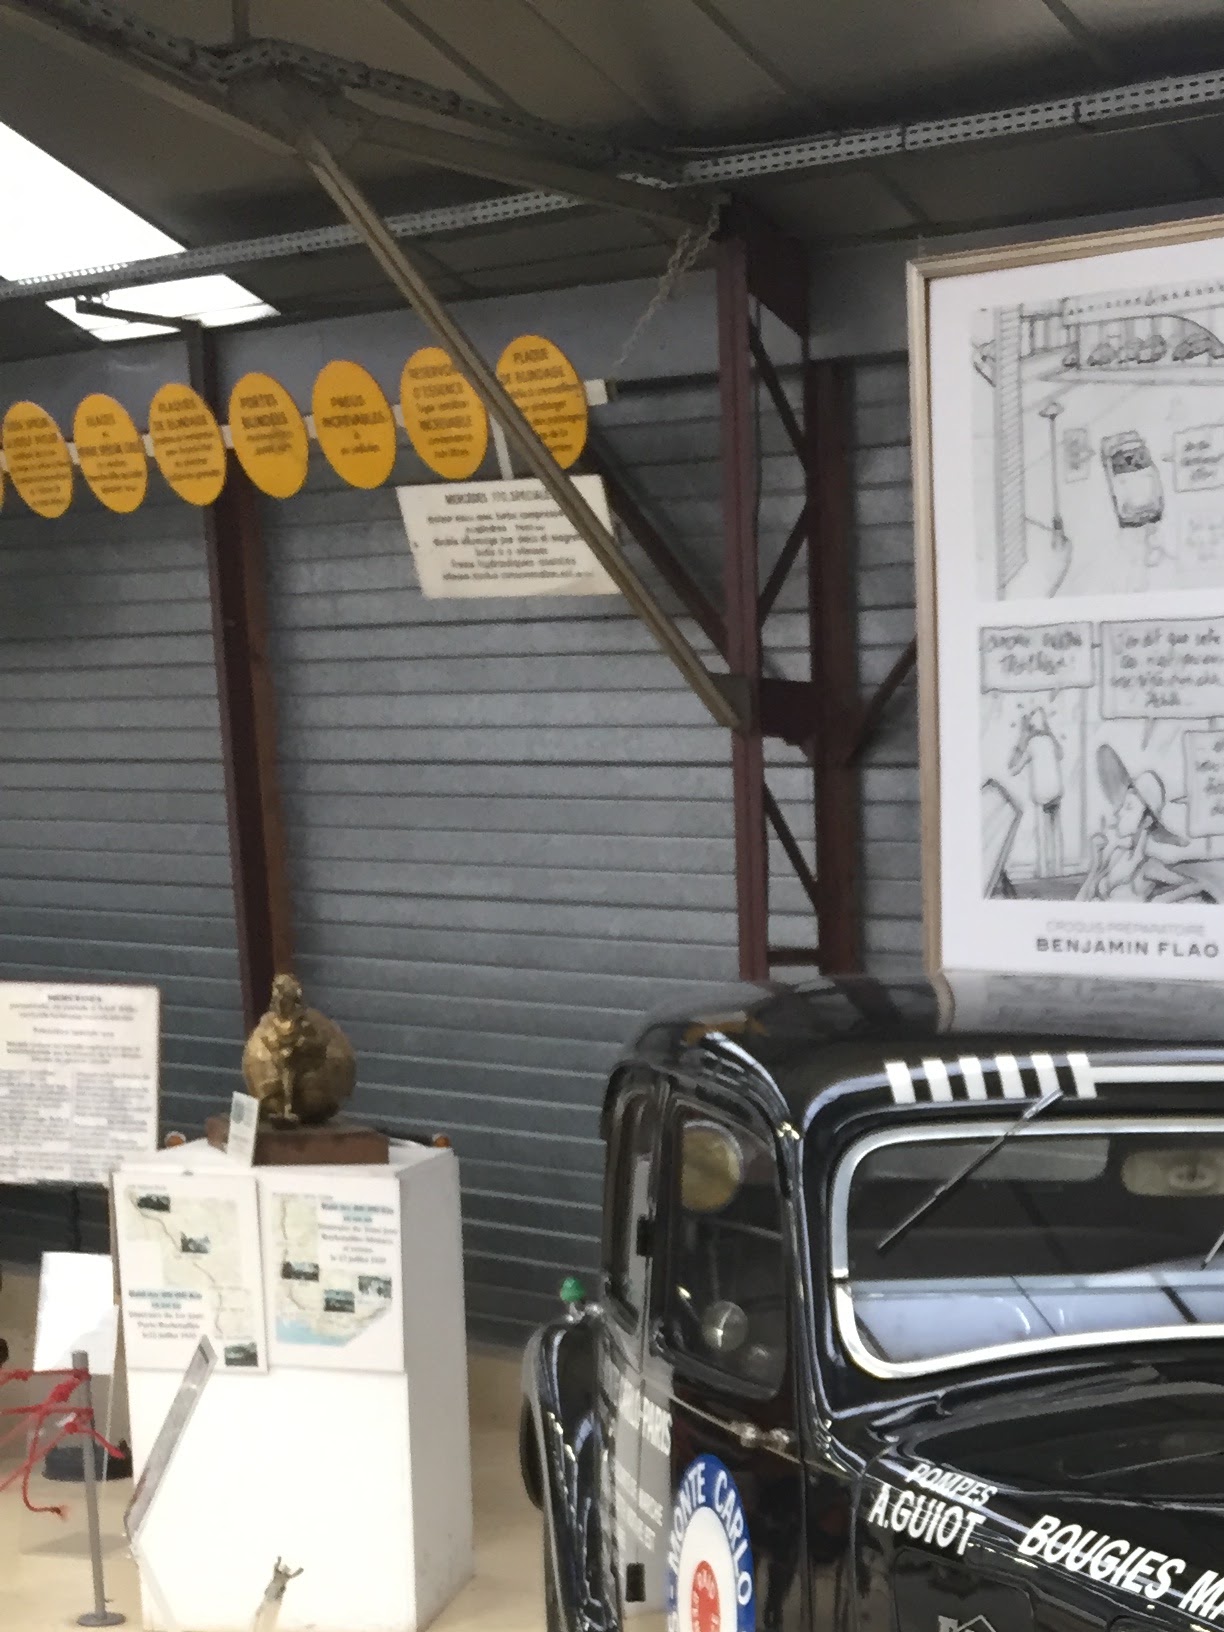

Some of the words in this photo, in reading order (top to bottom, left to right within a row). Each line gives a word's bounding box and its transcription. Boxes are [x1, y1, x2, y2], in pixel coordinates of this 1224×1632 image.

[1036, 938, 1149, 956] BENJAMIN
[1157, 942, 1219, 958] FLAO
[868, 1483, 987, 1556] A.GUIOT
[904, 1463, 998, 1507] POMPES
[667, 1461, 706, 1577] MONTE
[713, 1469, 753, 1606] CARLO
[1017, 1514, 1186, 1600] BOUGIES
